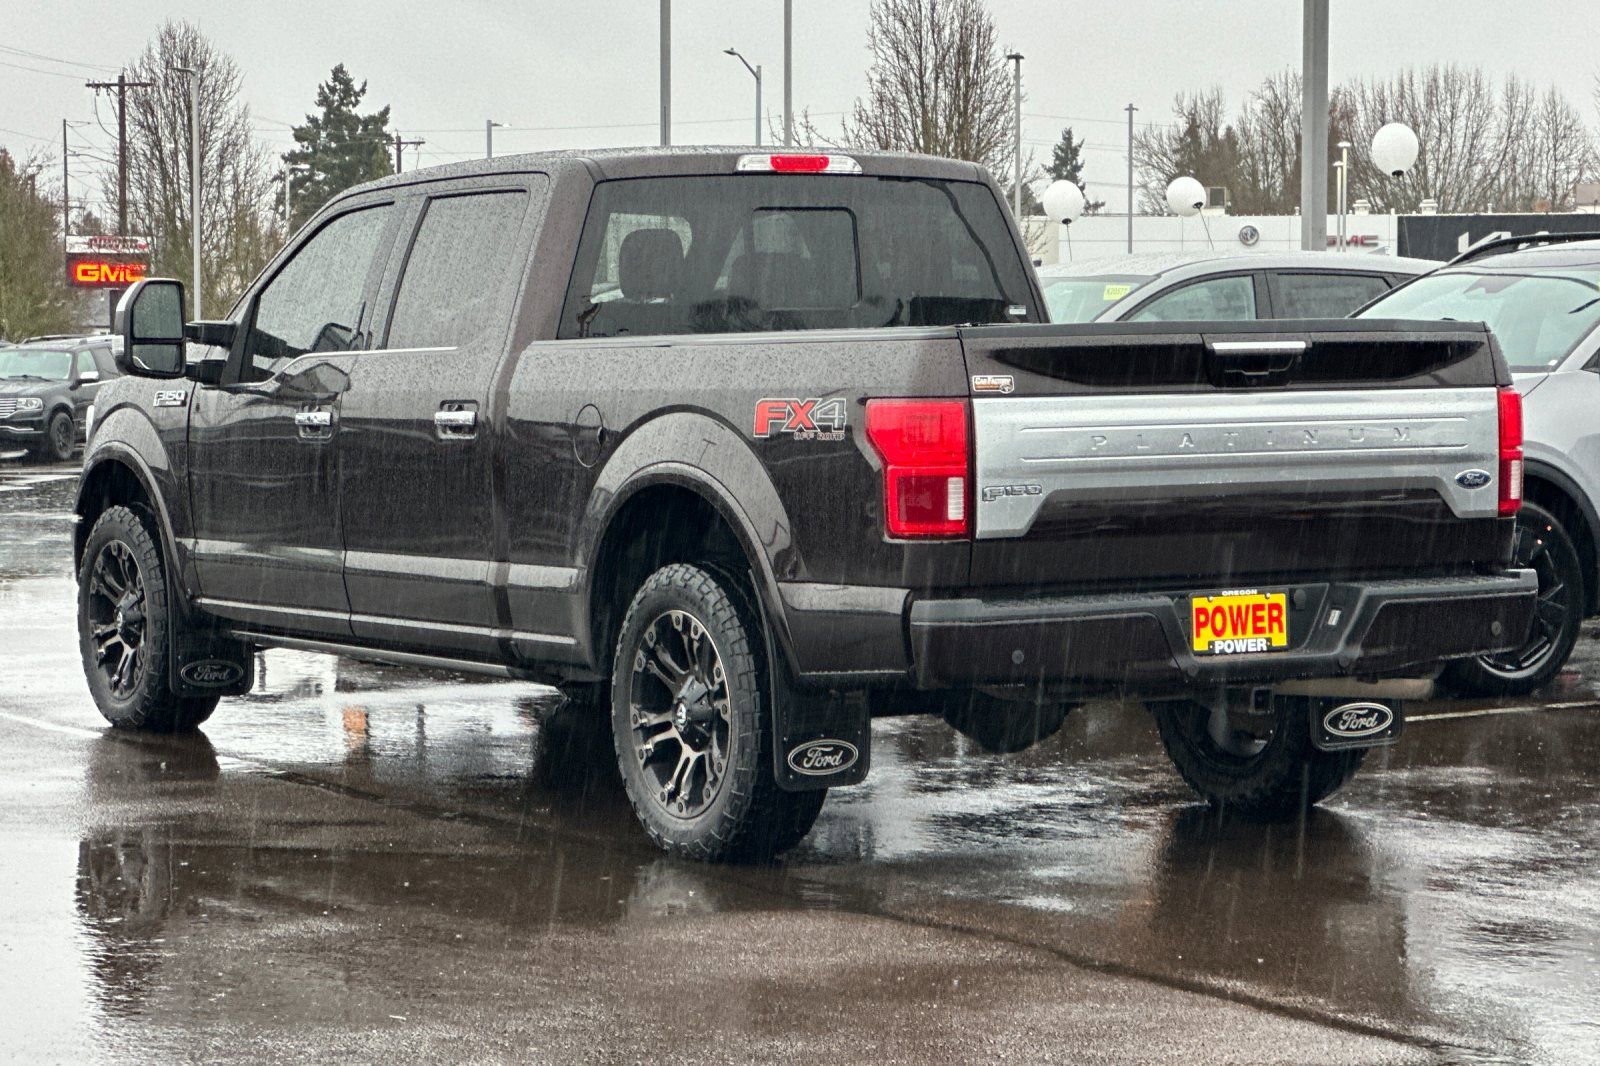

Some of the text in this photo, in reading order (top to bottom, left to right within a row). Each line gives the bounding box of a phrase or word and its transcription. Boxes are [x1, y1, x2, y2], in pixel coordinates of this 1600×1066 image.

[753, 397, 847, 437] FX4
[794, 431, 845, 440] OFF ROAD
[1091, 426, 1411, 450] PLATINUM
[1463, 473, 1485, 485] Ford
[1221, 589, 1258, 597] OREGON
[1195, 602, 1284, 638] POWER
[1214, 638, 1267, 654] POWER
[193, 665, 230, 681] Ford
[1339, 709, 1378, 730] Ford
[803, 746, 844, 768] Ford
